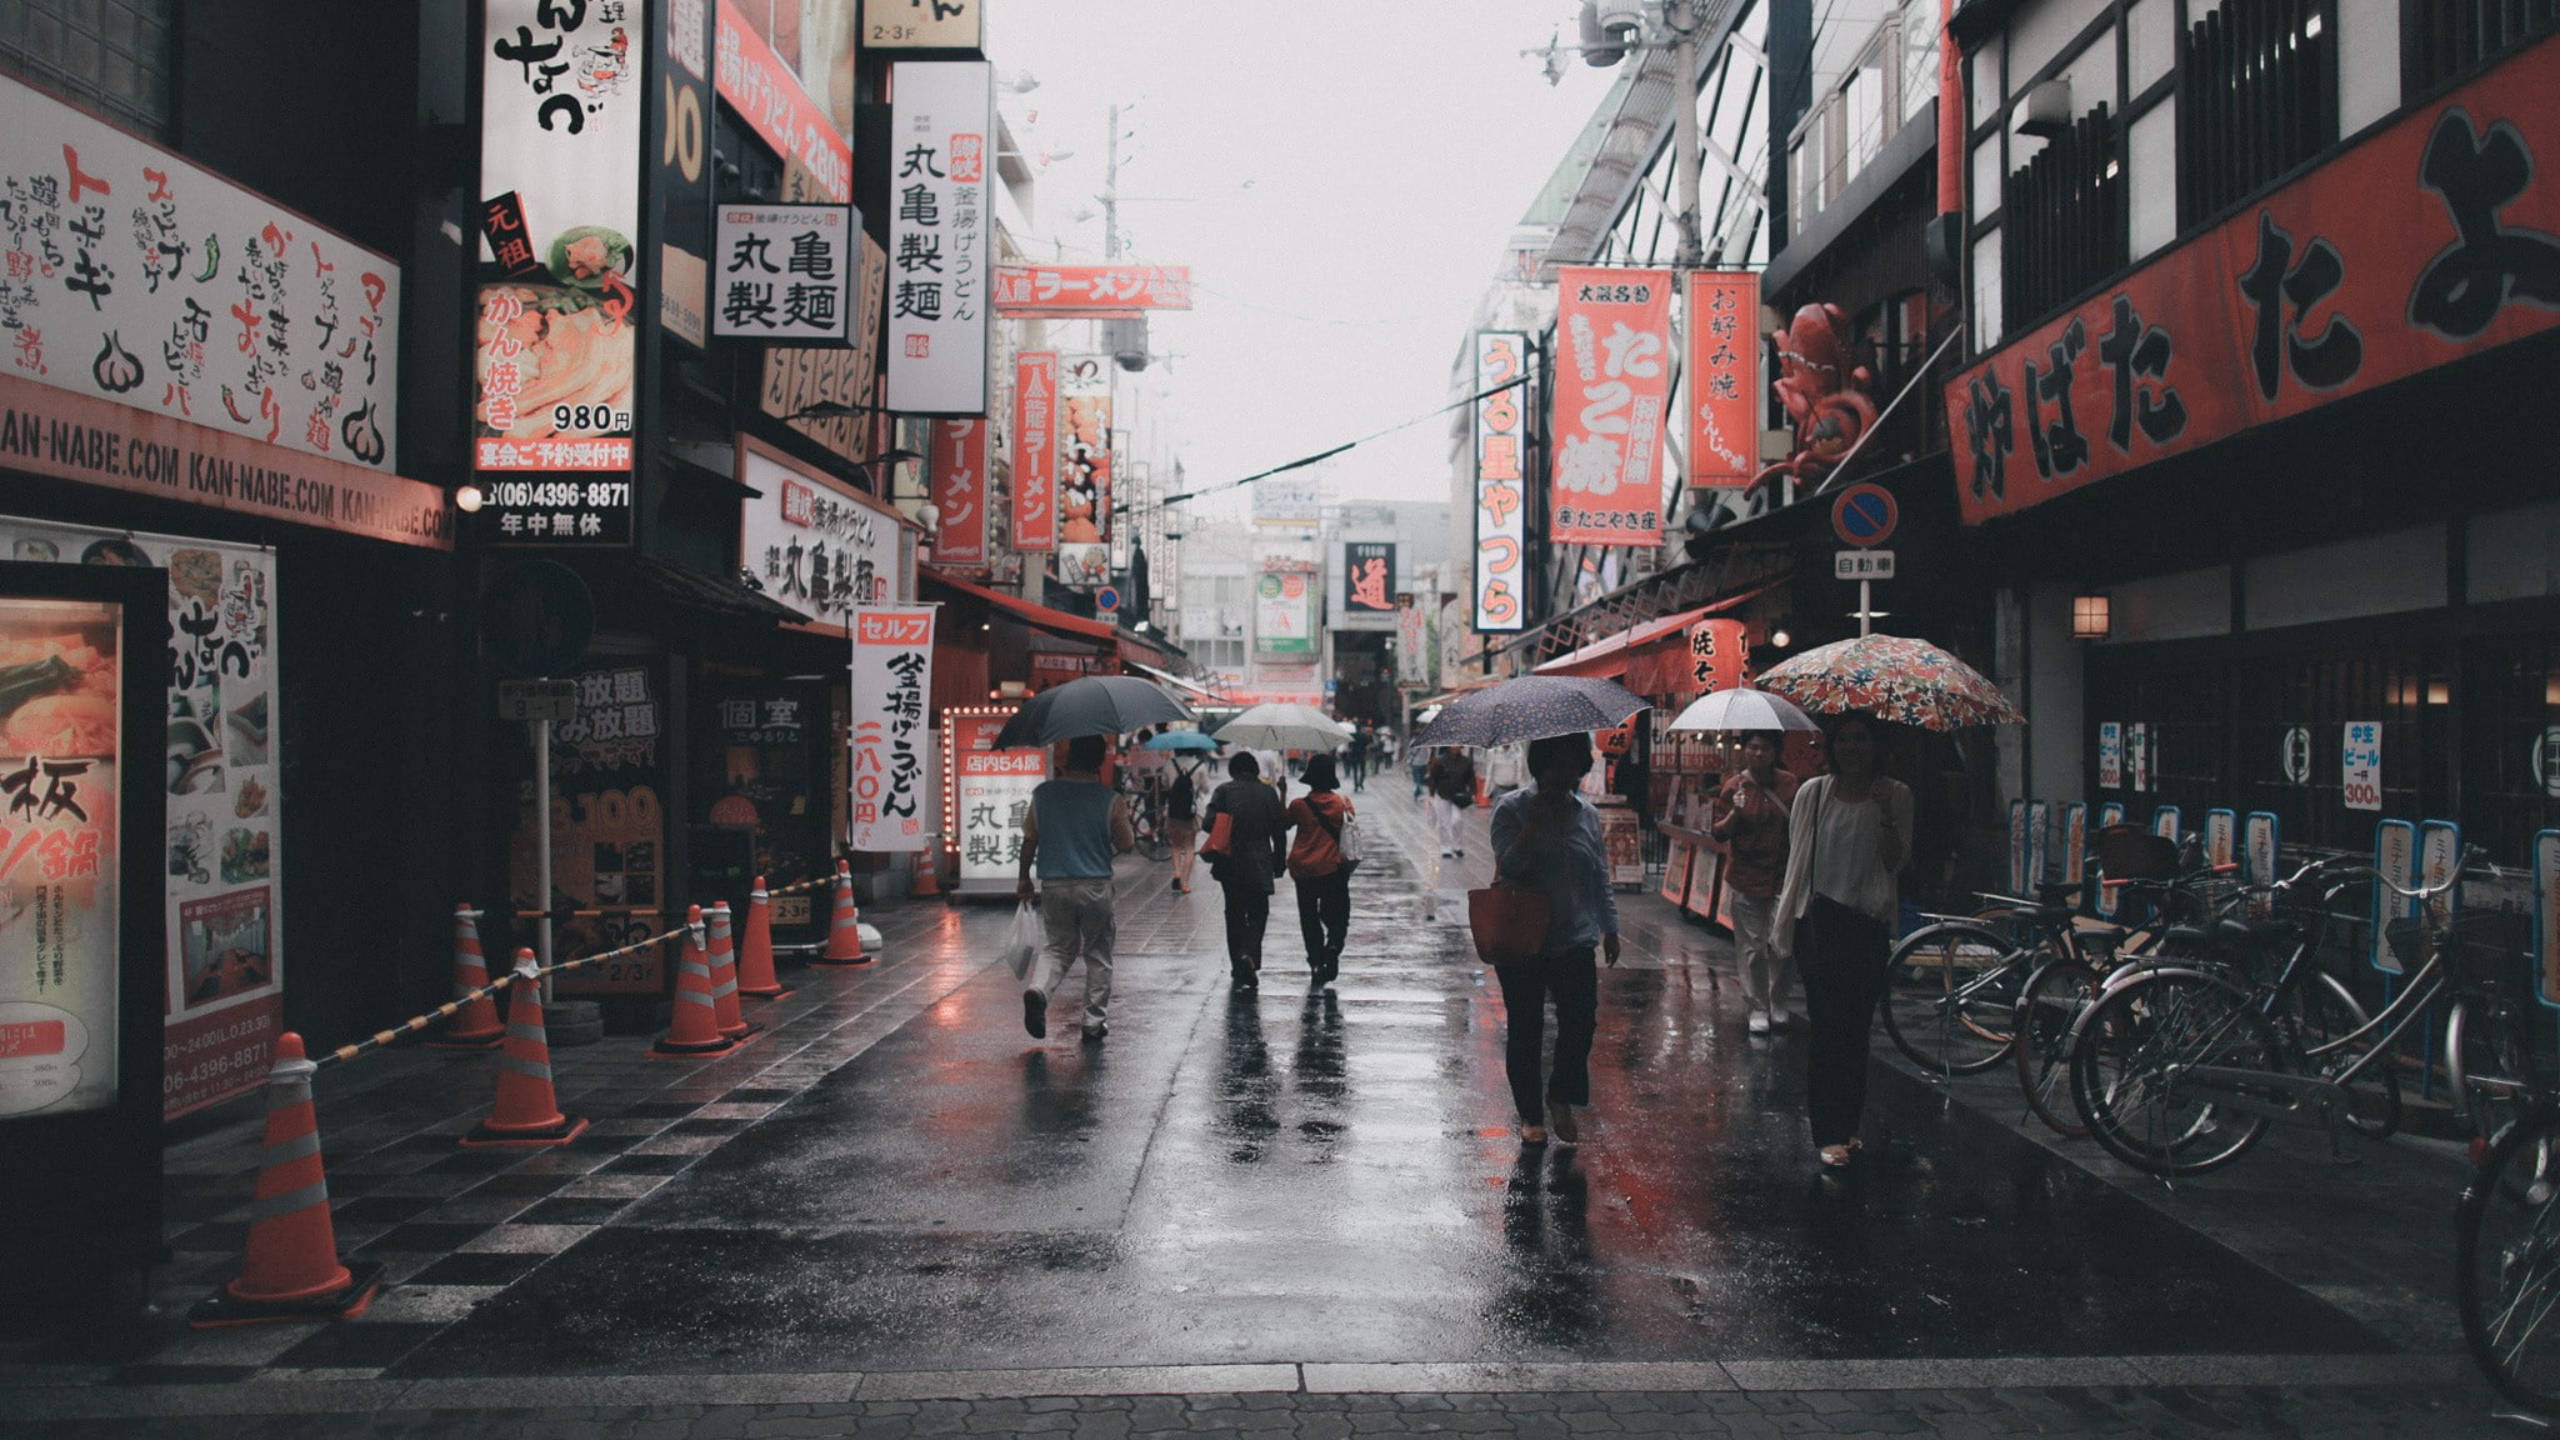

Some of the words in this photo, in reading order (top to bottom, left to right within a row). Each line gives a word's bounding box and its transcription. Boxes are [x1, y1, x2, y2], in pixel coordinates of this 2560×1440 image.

[62, 143, 112, 311] トッポギ
[488, 204, 531, 269] 元祖
[727, 230, 835, 280] 丸亀
[895, 144, 946, 321] 丸亀製麺
[952, 187, 977, 322] 釜揚げうどん
[722, 281, 838, 331] 製麺
[1579, 285, 1651, 302] 大阪名物
[486, 294, 522, 431] かん焼き
[1709, 289, 1739, 400] お好み焼
[554, 404, 631, 431] 980円
[1557, 321, 1662, 495] たこ焼
[1964, 293, 2189, 501] 炉ばた
[480, 442, 630, 467] 宴会ご予約受付中
[1479, 339, 1521, 624] うる星やつら
[189, 452, 334, 518] KAN-NABE.COM
[501, 513, 602, 536] 年中無休
[1839, 557, 1892, 573] 自動車
[862, 614, 929, 641] セルフ
[577, 670, 650, 705] 放題
[717, 698, 801, 730] 個室
[882, 651, 926, 819] 釜揚げうどん
[966, 754, 1041, 773] 店内54席
